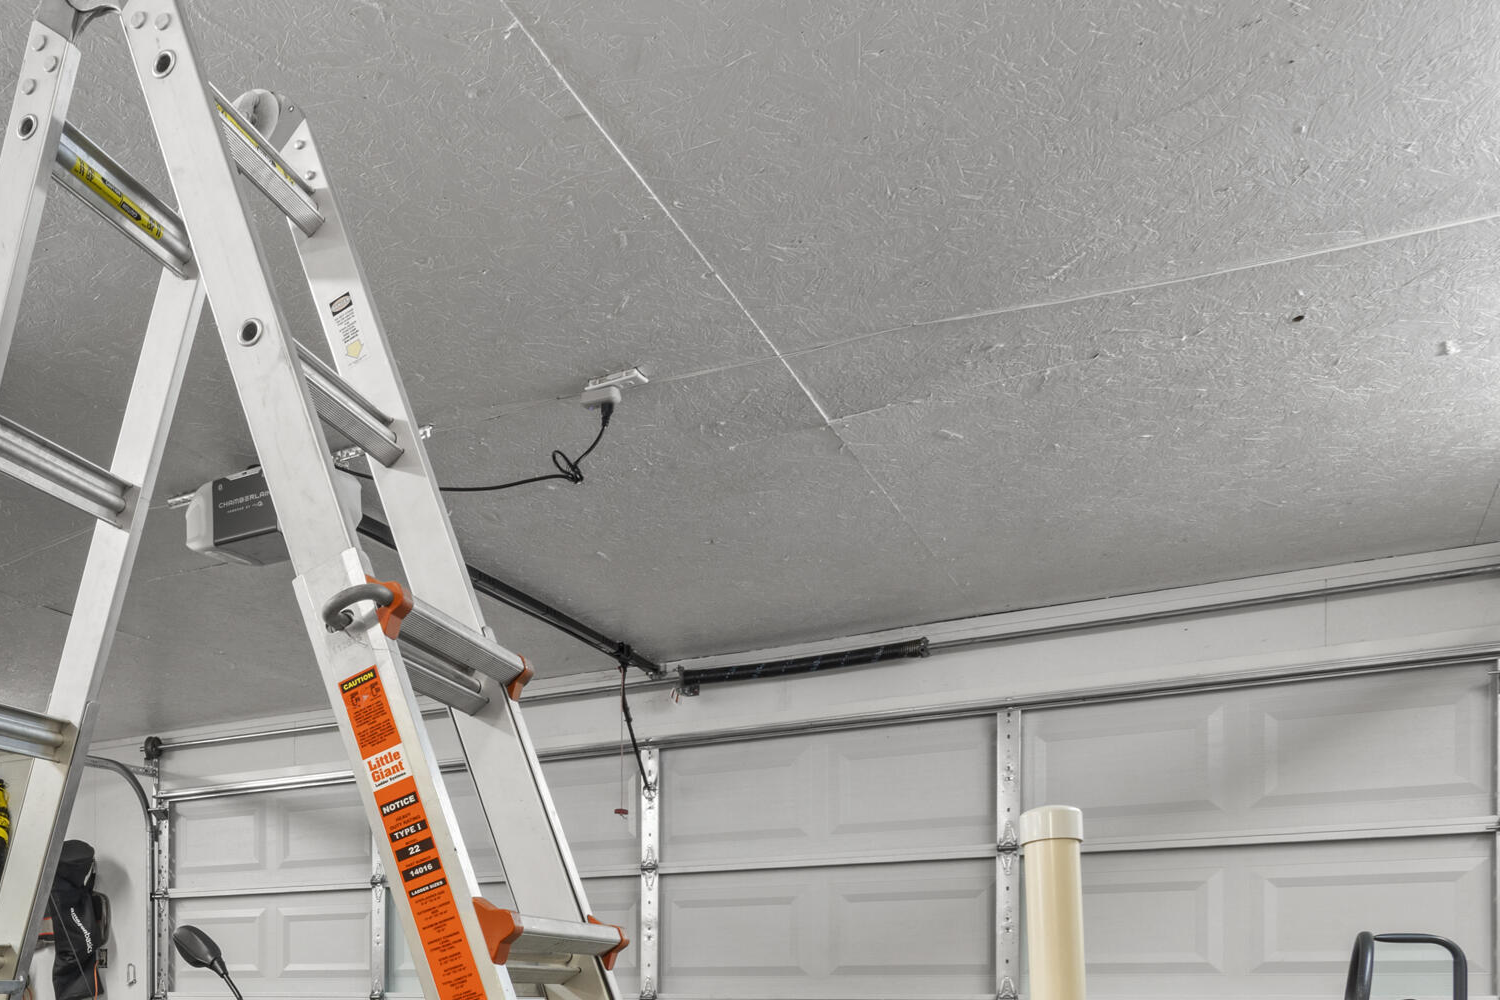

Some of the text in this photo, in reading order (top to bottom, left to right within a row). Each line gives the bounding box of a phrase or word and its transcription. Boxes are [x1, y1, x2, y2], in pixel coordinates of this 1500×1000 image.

[342, 671, 374, 690] CAUTION
[367, 751, 401, 771] Little
[371, 760, 405, 783] Giant
[382, 794, 416, 815] NOTICE
[393, 825, 416, 840] TYPE
[408, 844, 421, 855] 22
[409, 863, 433, 877] 14016
